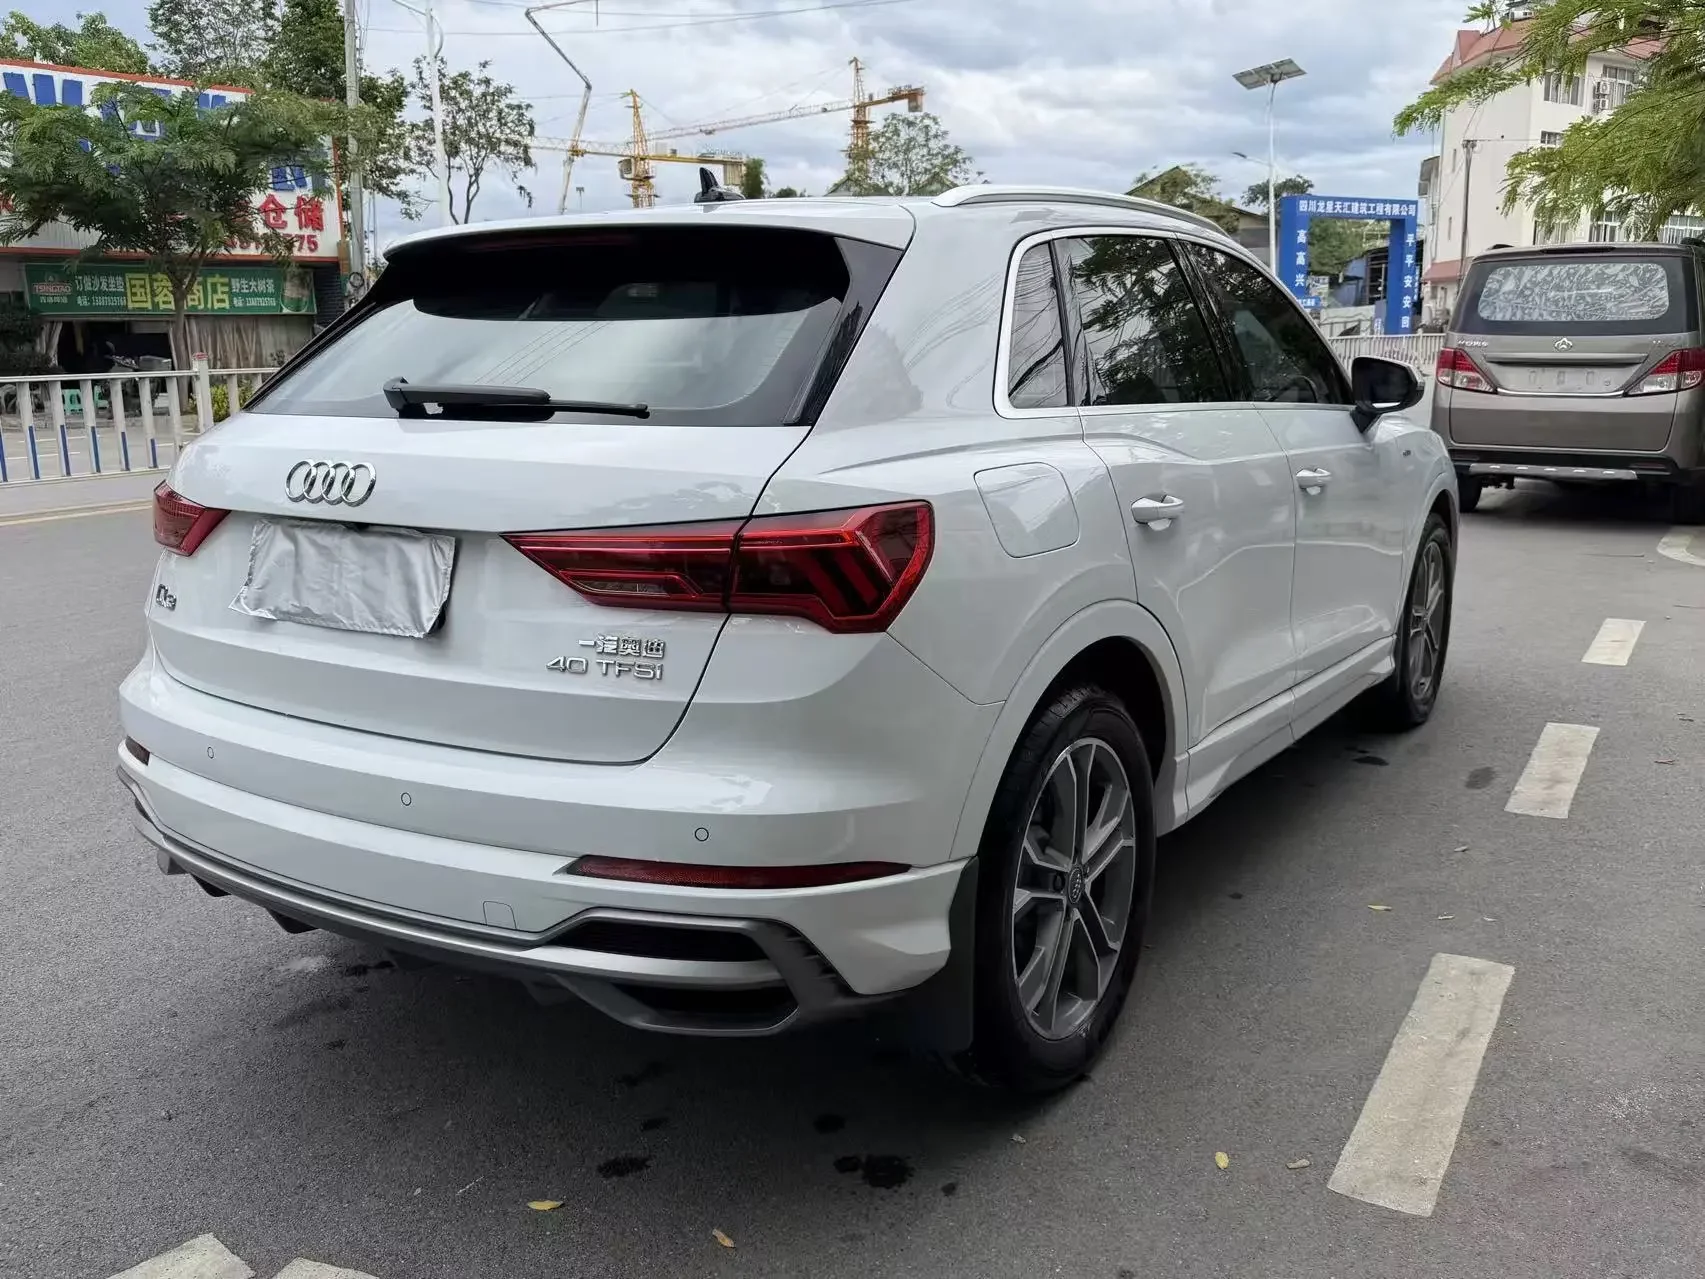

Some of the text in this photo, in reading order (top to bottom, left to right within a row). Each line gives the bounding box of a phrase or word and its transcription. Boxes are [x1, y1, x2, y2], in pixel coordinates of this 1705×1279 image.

[578, 632, 665, 659] 一汽奥迪
[546, 655, 588, 675] 40
